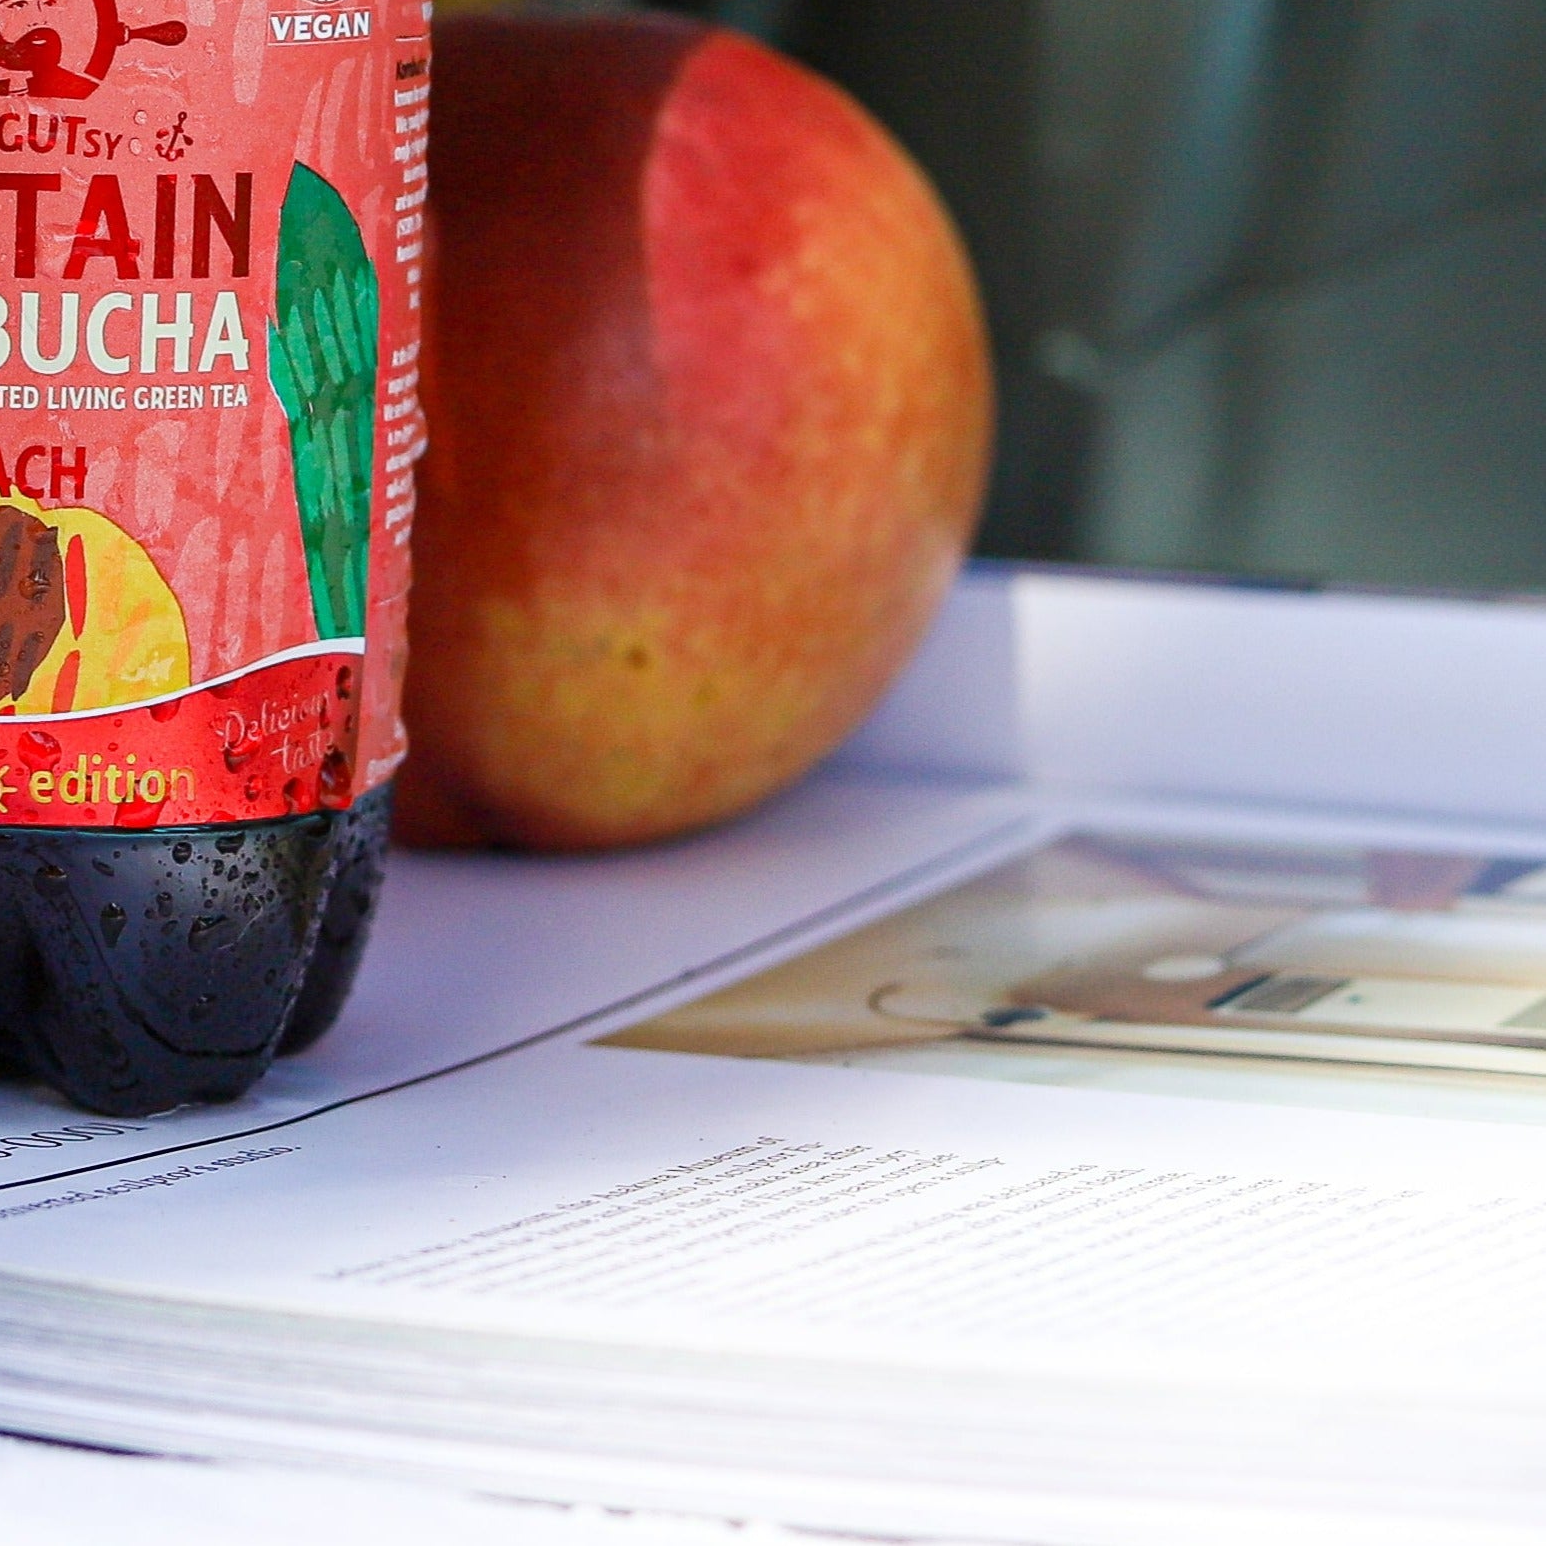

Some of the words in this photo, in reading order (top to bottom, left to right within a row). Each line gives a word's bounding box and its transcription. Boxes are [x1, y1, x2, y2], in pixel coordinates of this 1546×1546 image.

[270, 12, 371, 41] VEGAN
[47, 385, 126, 410] LIVING
[133, 386, 203, 409] GREEN
[211, 384, 249, 408] TEA
[28, 754, 196, 805] edition
[210, 1144, 302, 1168] studio.
